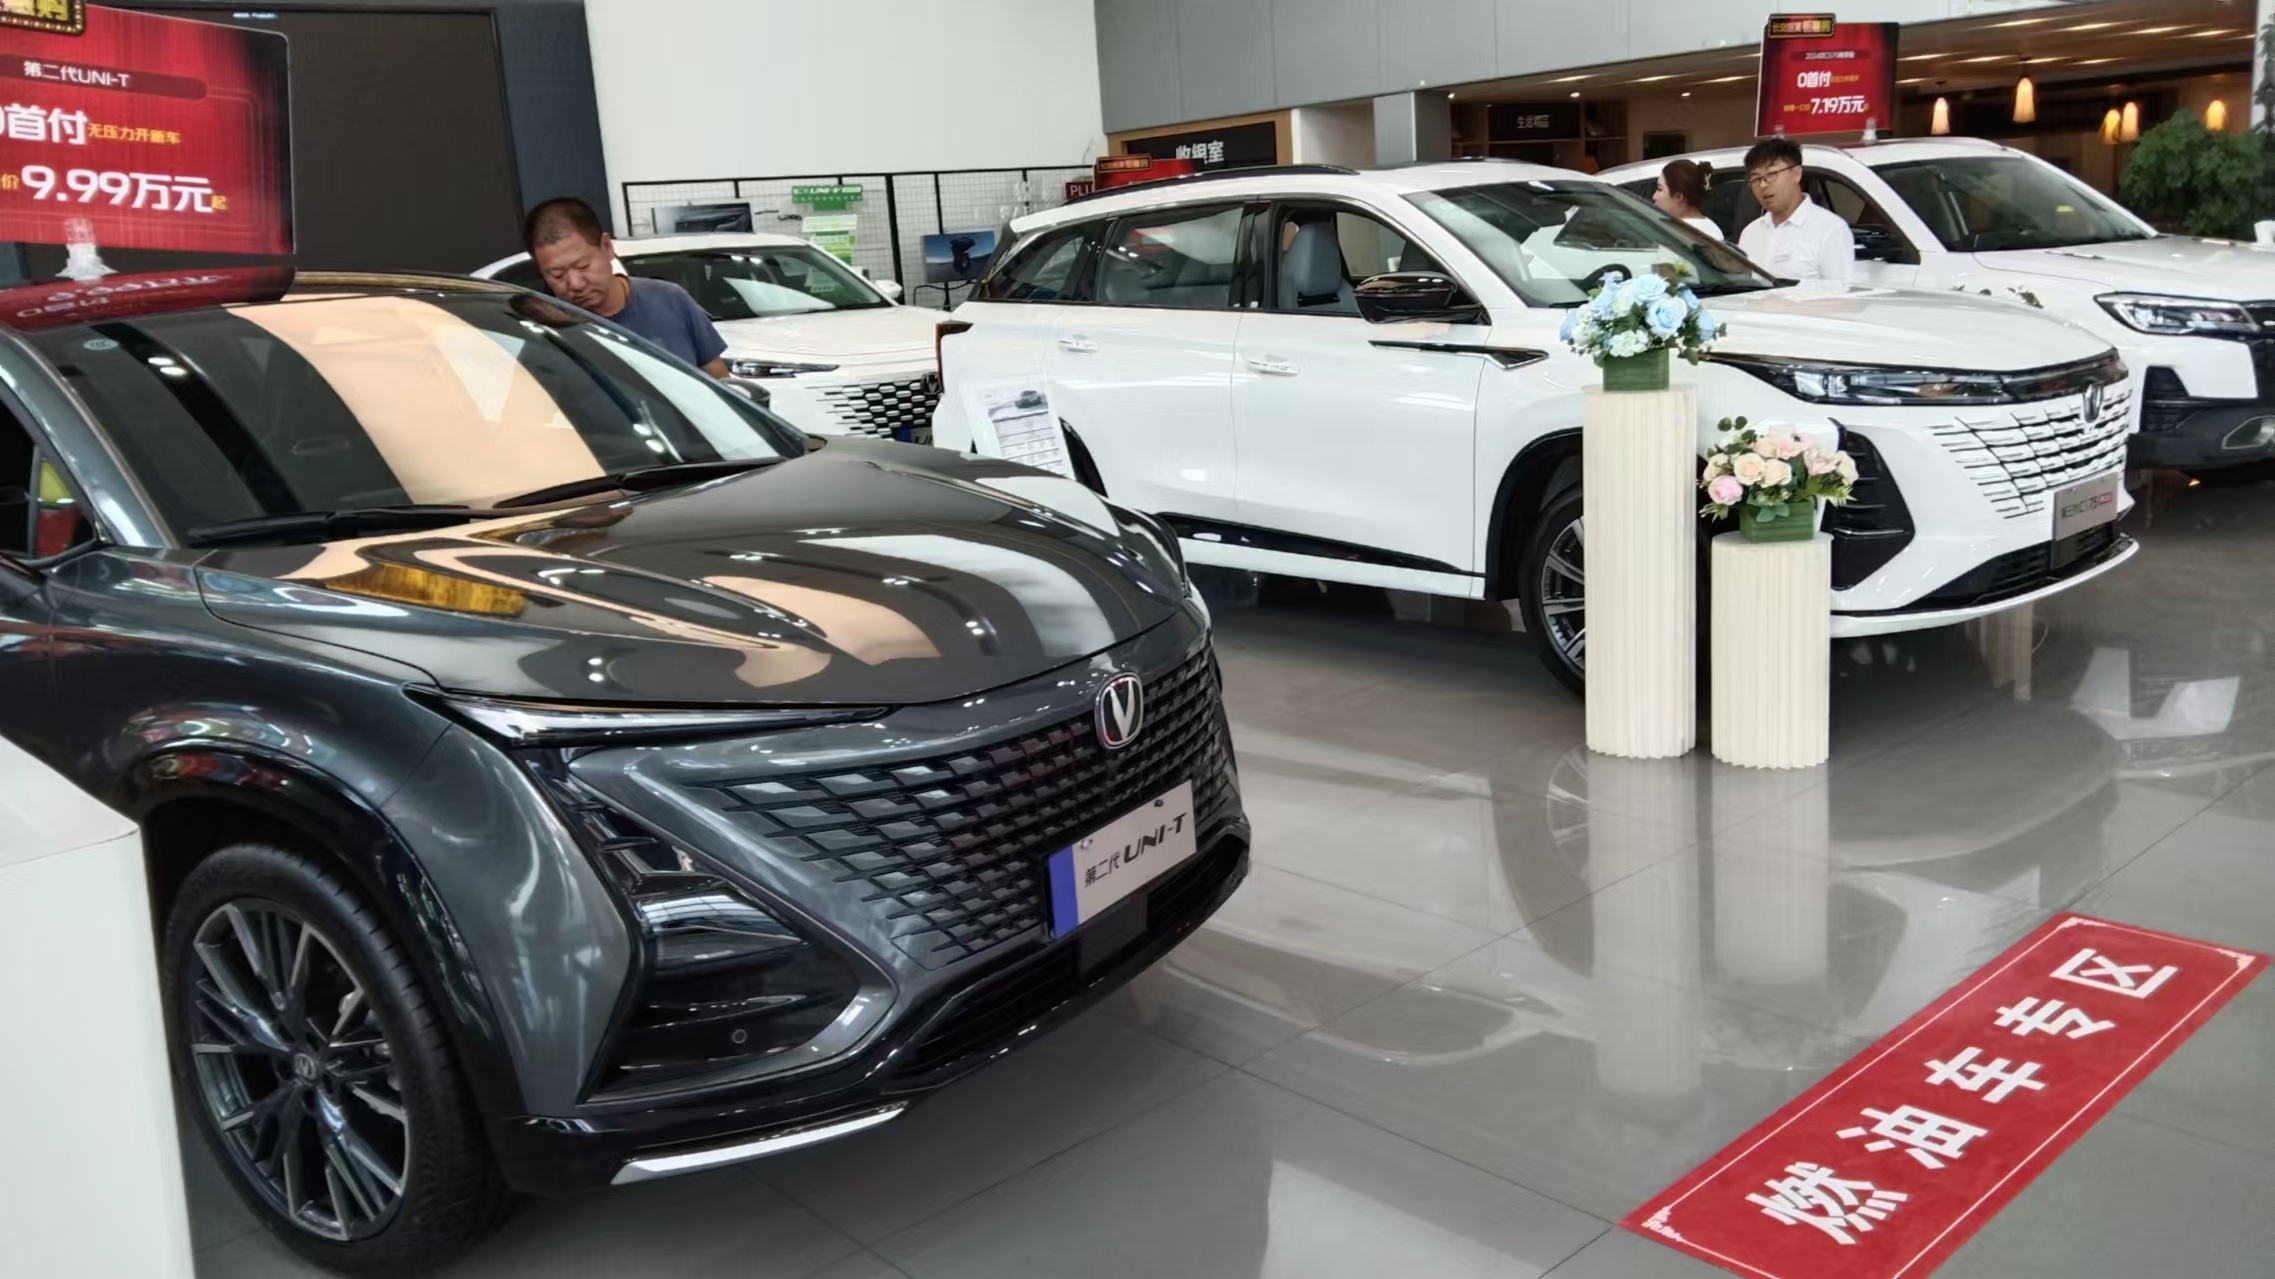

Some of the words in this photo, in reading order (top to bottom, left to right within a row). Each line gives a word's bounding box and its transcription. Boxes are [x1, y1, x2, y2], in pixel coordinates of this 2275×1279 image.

[24, 60, 131, 88] 第二代UNI-T
[1797, 71, 1832, 88] 0首付
[1810, 95, 1865, 115] 7.19万元
[0, 103, 88, 145] 首付
[1176, 140, 1225, 165] 收银室
[20, 165, 214, 213] 9.99万元
[1084, 852, 1121, 888] 第二代
[1123, 812, 1187, 864] UNI-T
[1745, 948, 2178, 1245] 燃油车专区
